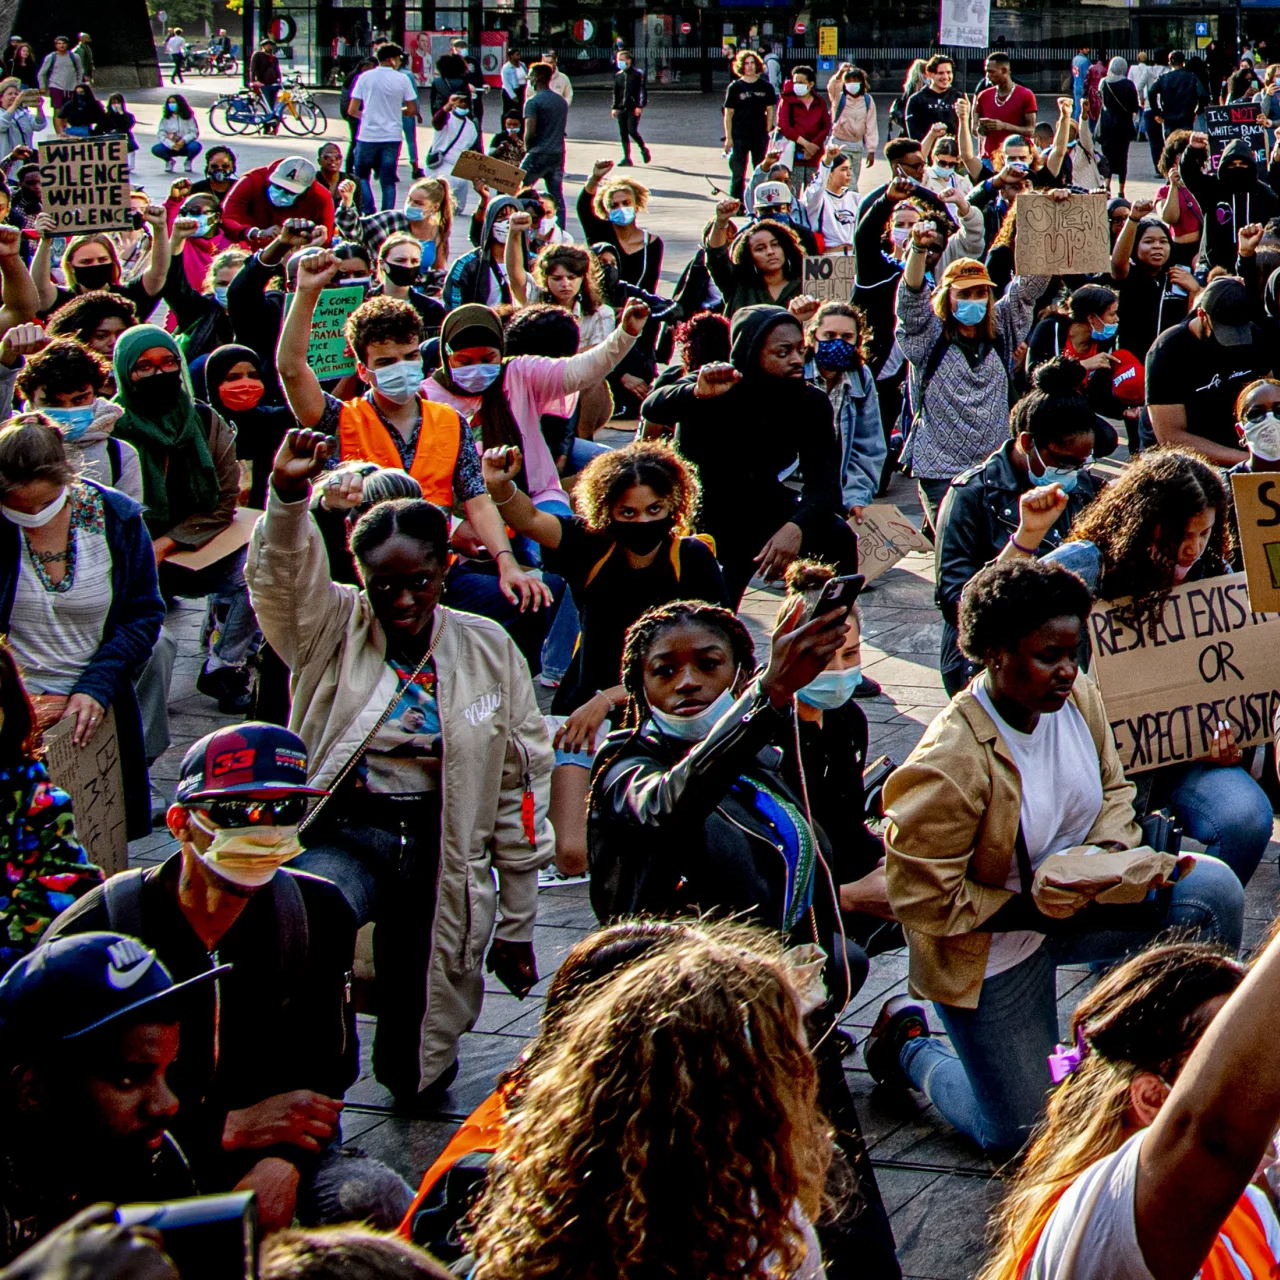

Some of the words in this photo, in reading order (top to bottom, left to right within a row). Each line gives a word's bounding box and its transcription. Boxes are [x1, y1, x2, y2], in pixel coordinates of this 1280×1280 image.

[1231, 107, 1257, 122] NOT
[1208, 125, 1234, 136] WHITE
[46, 141, 121, 163] WHITE
[40, 163, 129, 187] SILENCE
[48, 185, 122, 206] WHITE
[1025, 195, 1110, 245] SPEAK
[1043, 228, 1087, 268] UP
[806, 257, 834, 280] NO
[320, 308, 344, 317] WHEN
[329, 296, 358, 306] COMES
[332, 362, 356, 371] MATTER
[1091, 594, 1185, 657] RESPECT
[1199, 641, 1244, 683] OR
[1110, 704, 1193, 770] EXPECT
[213, 748, 257, 776] 33
